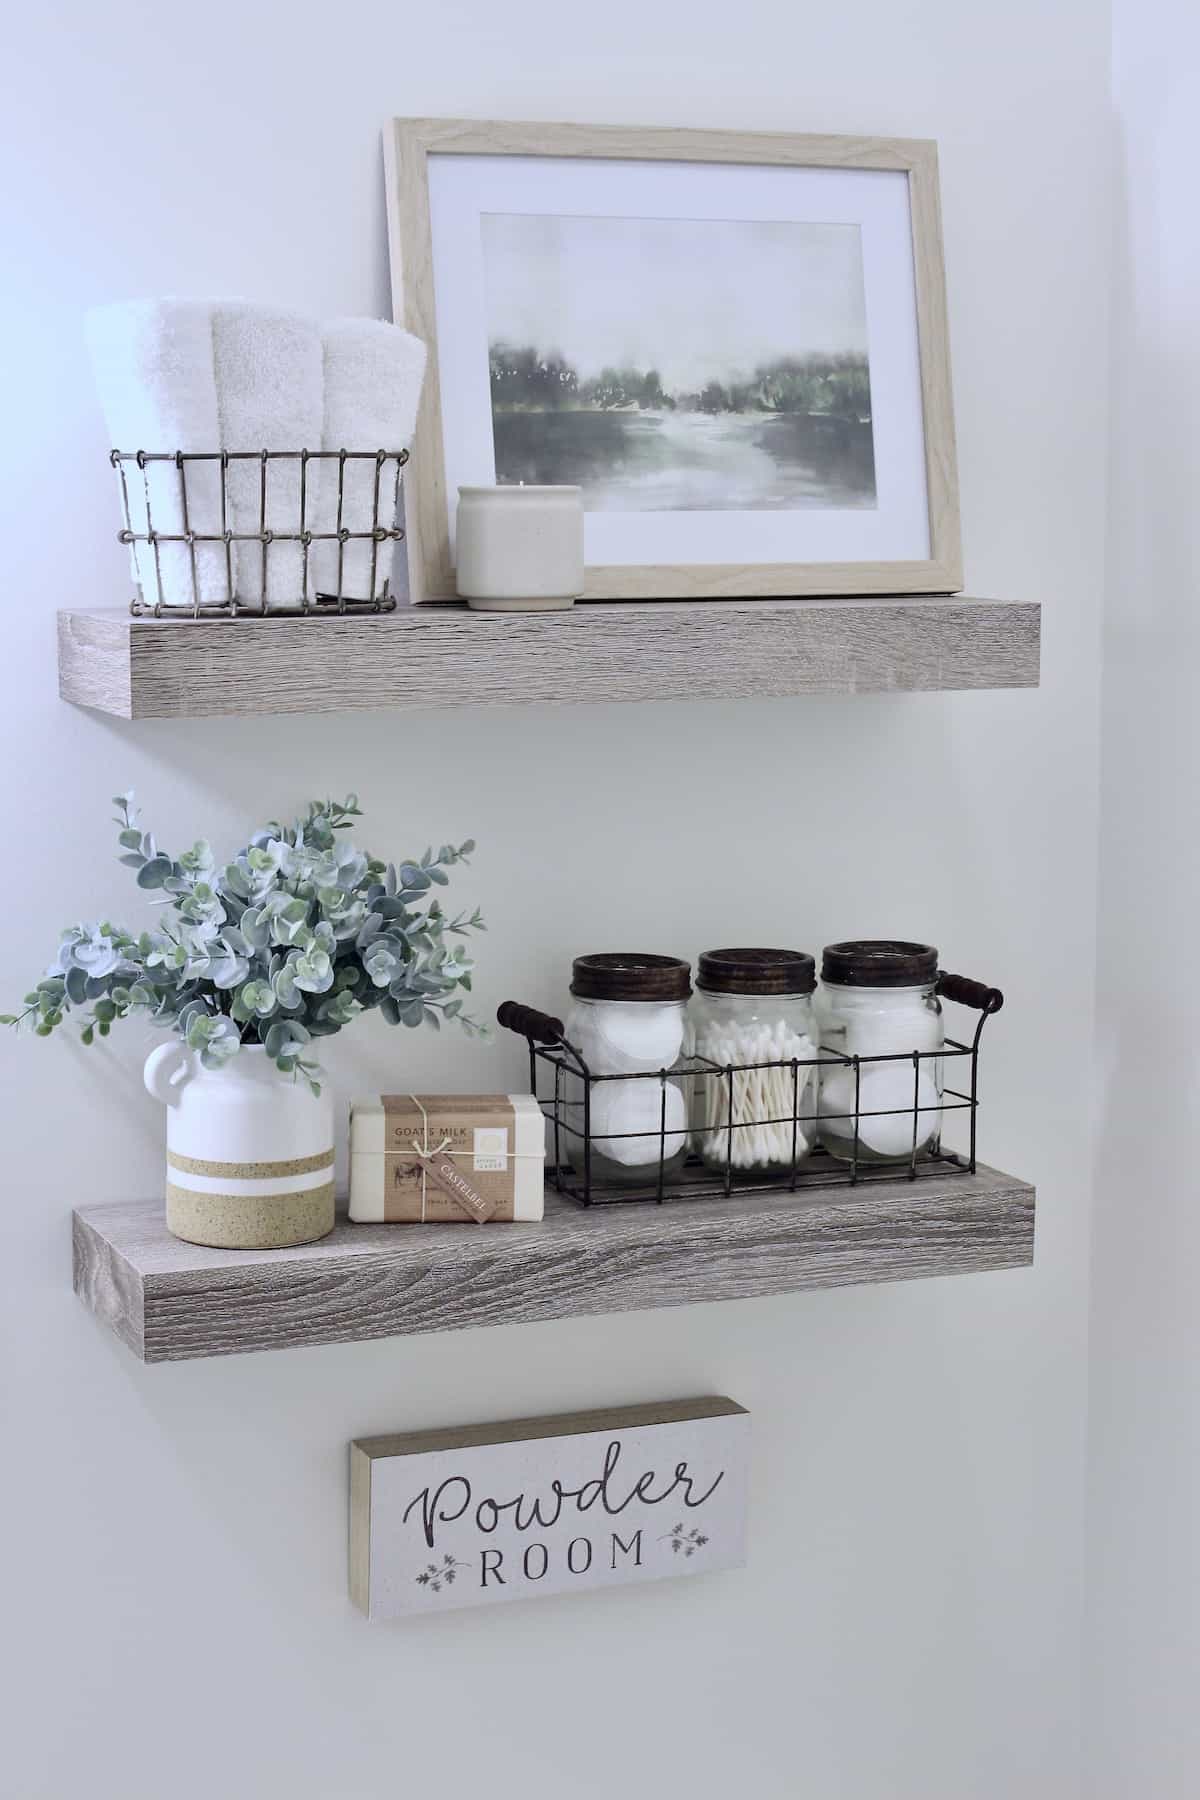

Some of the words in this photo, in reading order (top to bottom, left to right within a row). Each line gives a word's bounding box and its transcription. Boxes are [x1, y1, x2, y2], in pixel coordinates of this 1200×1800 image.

[439, 1127, 467, 1137] MILK
[402, 1440, 724, 1548] Powder
[479, 1529, 644, 1588] ROOM
